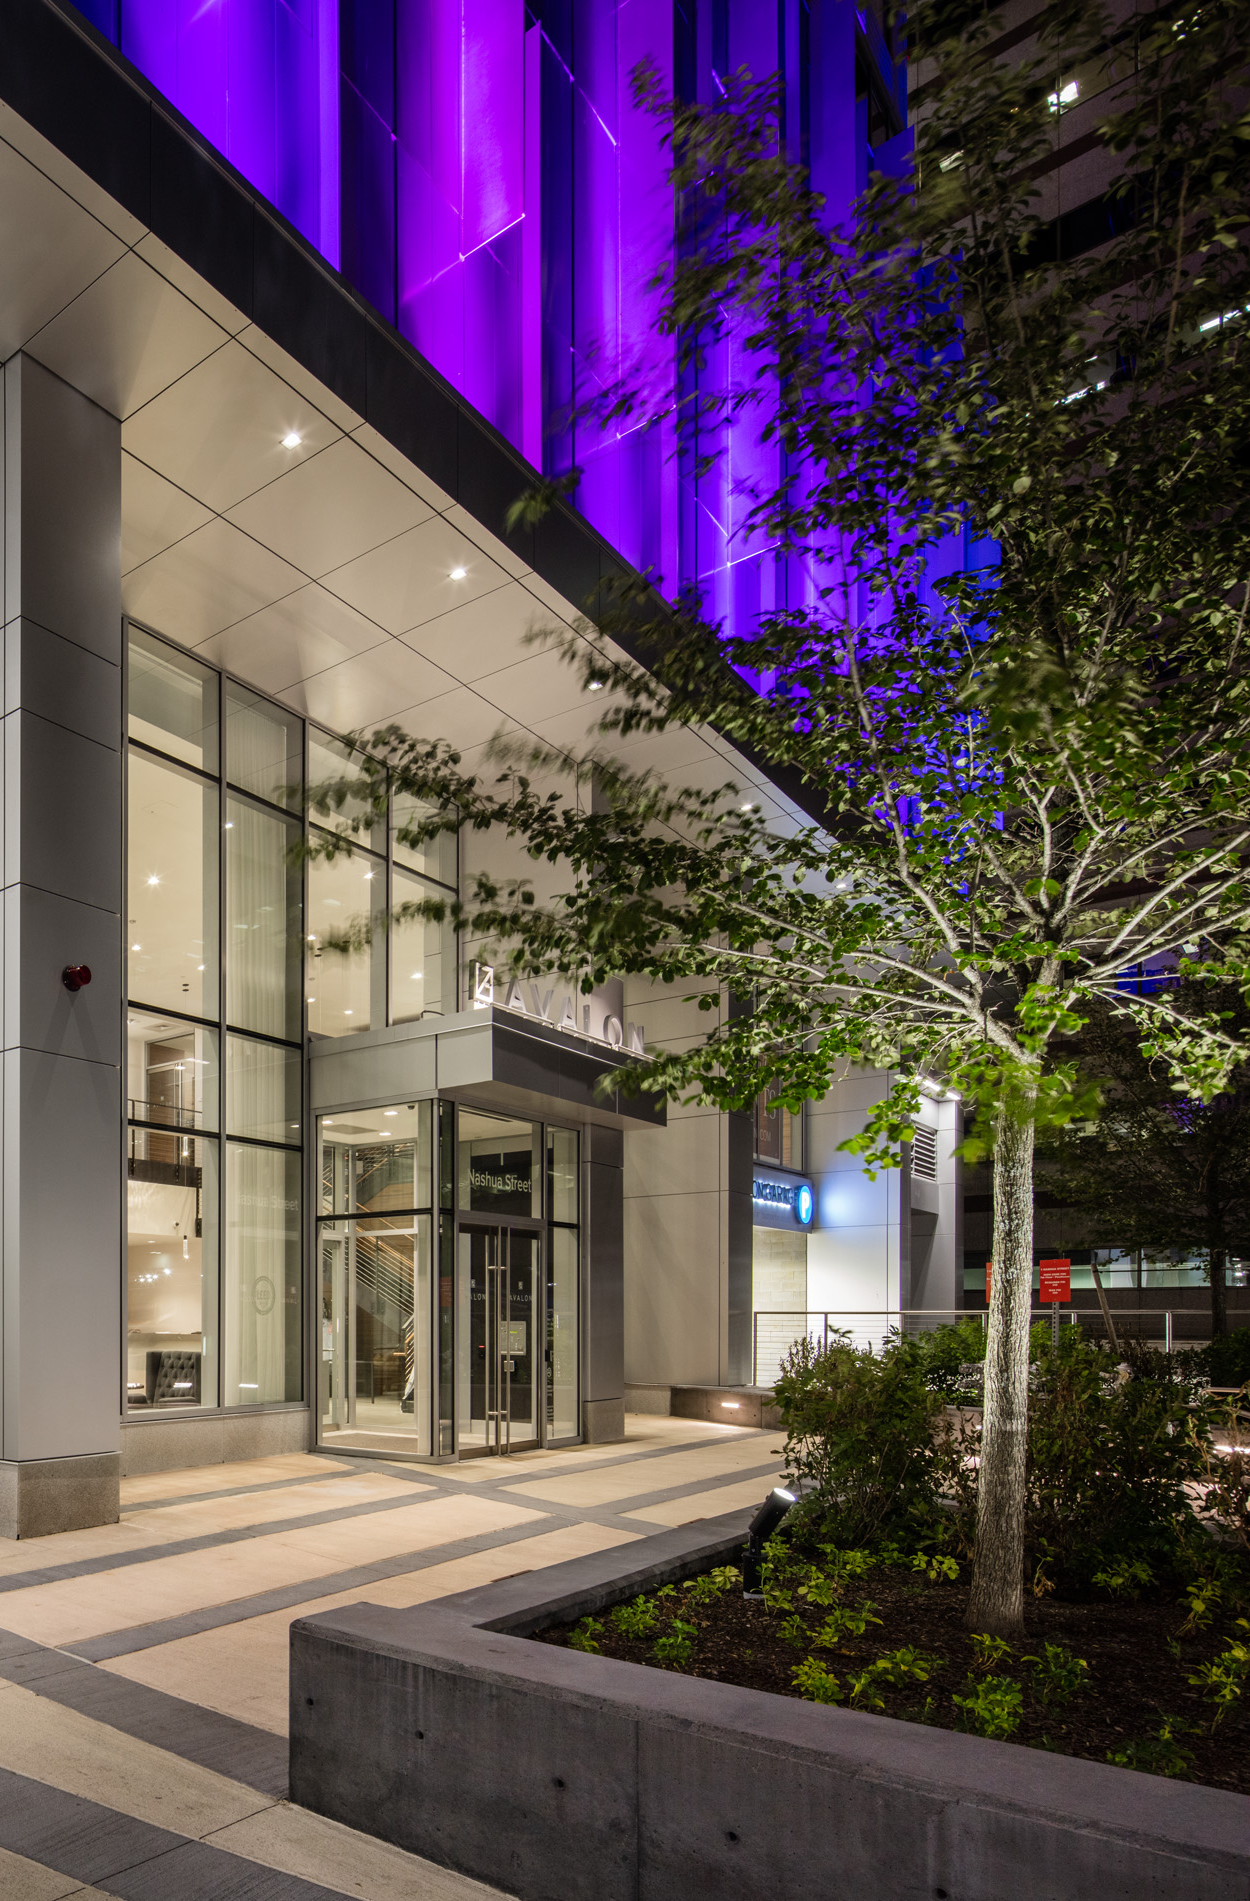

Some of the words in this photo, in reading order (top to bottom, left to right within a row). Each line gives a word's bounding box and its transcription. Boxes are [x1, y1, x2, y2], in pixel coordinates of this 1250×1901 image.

[504, 977, 645, 1054] AVALON
[469, 1169, 503, 1188] Nashua
[505, 1174, 532, 1193] Street
[801, 1191, 810, 1219] P
